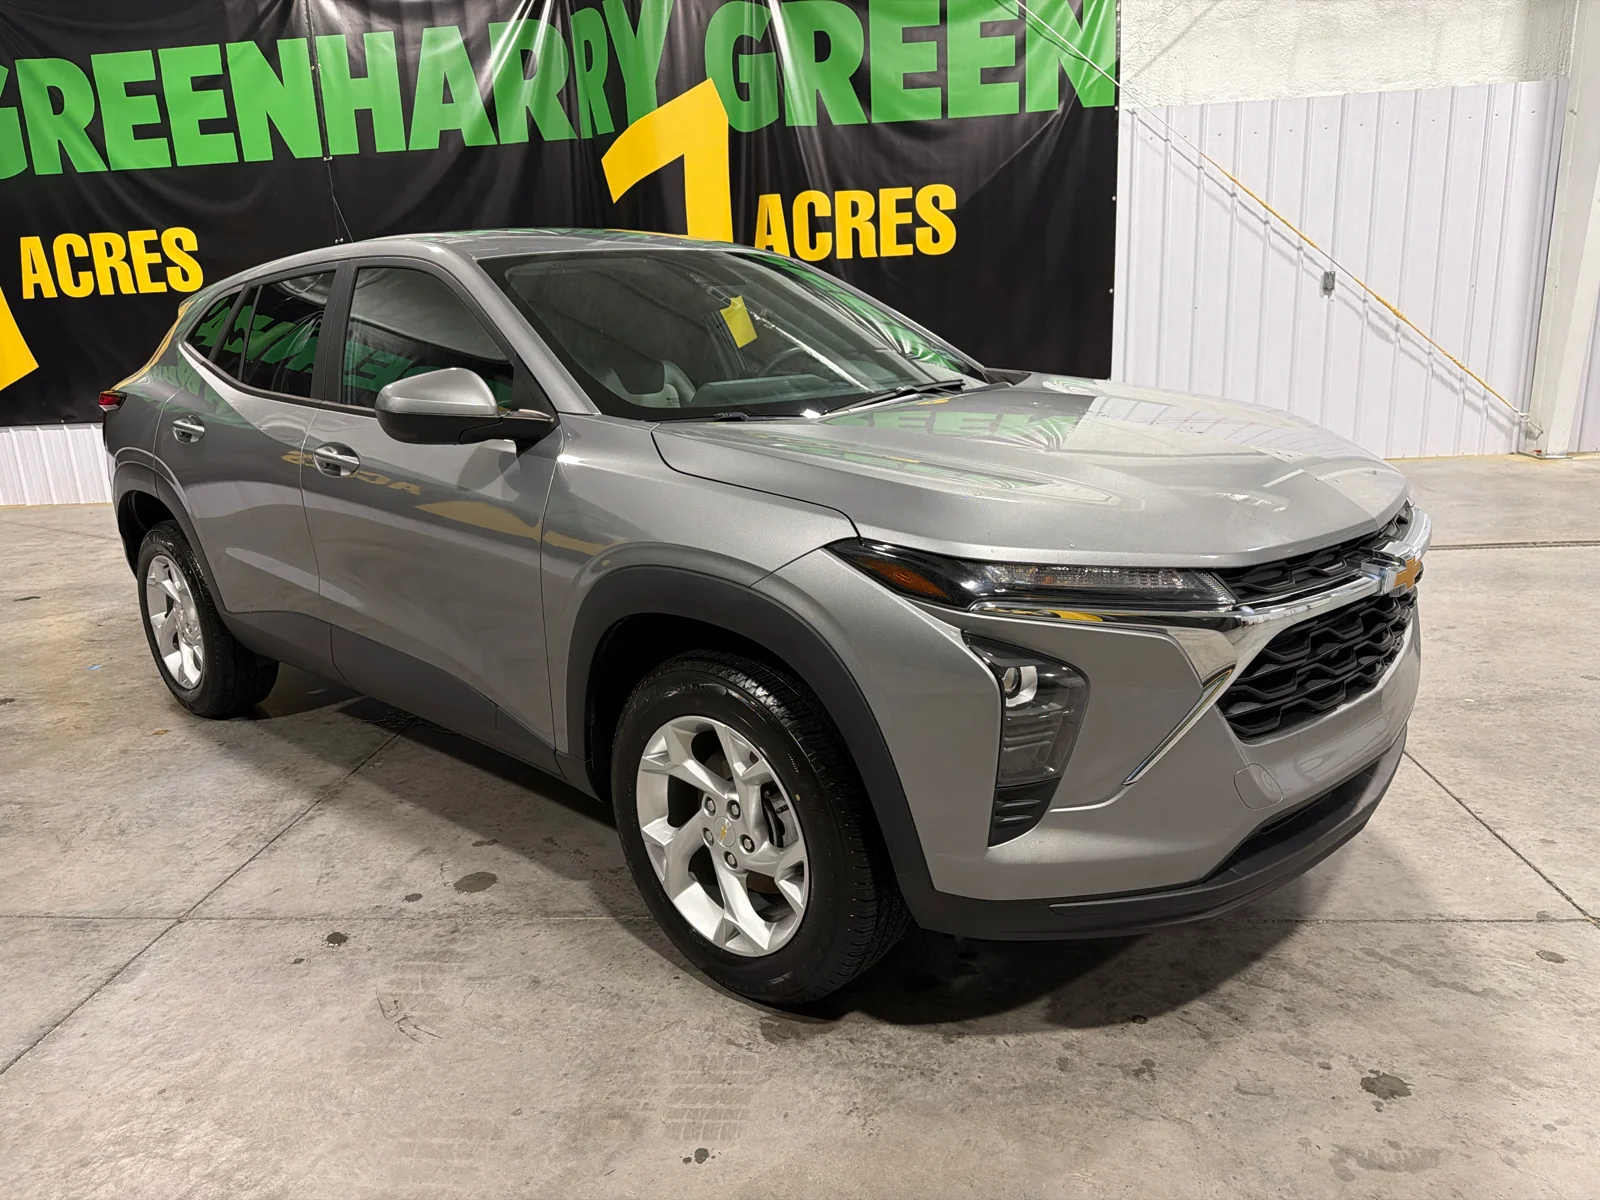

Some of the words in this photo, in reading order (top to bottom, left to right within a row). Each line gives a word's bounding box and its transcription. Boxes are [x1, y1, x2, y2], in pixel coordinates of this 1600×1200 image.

[314, 0, 674, 155] HARRY
[704, 0, 1117, 132] GREEN
[754, 184, 957, 262] ACRES
[20, 226, 204, 300] ACRES
